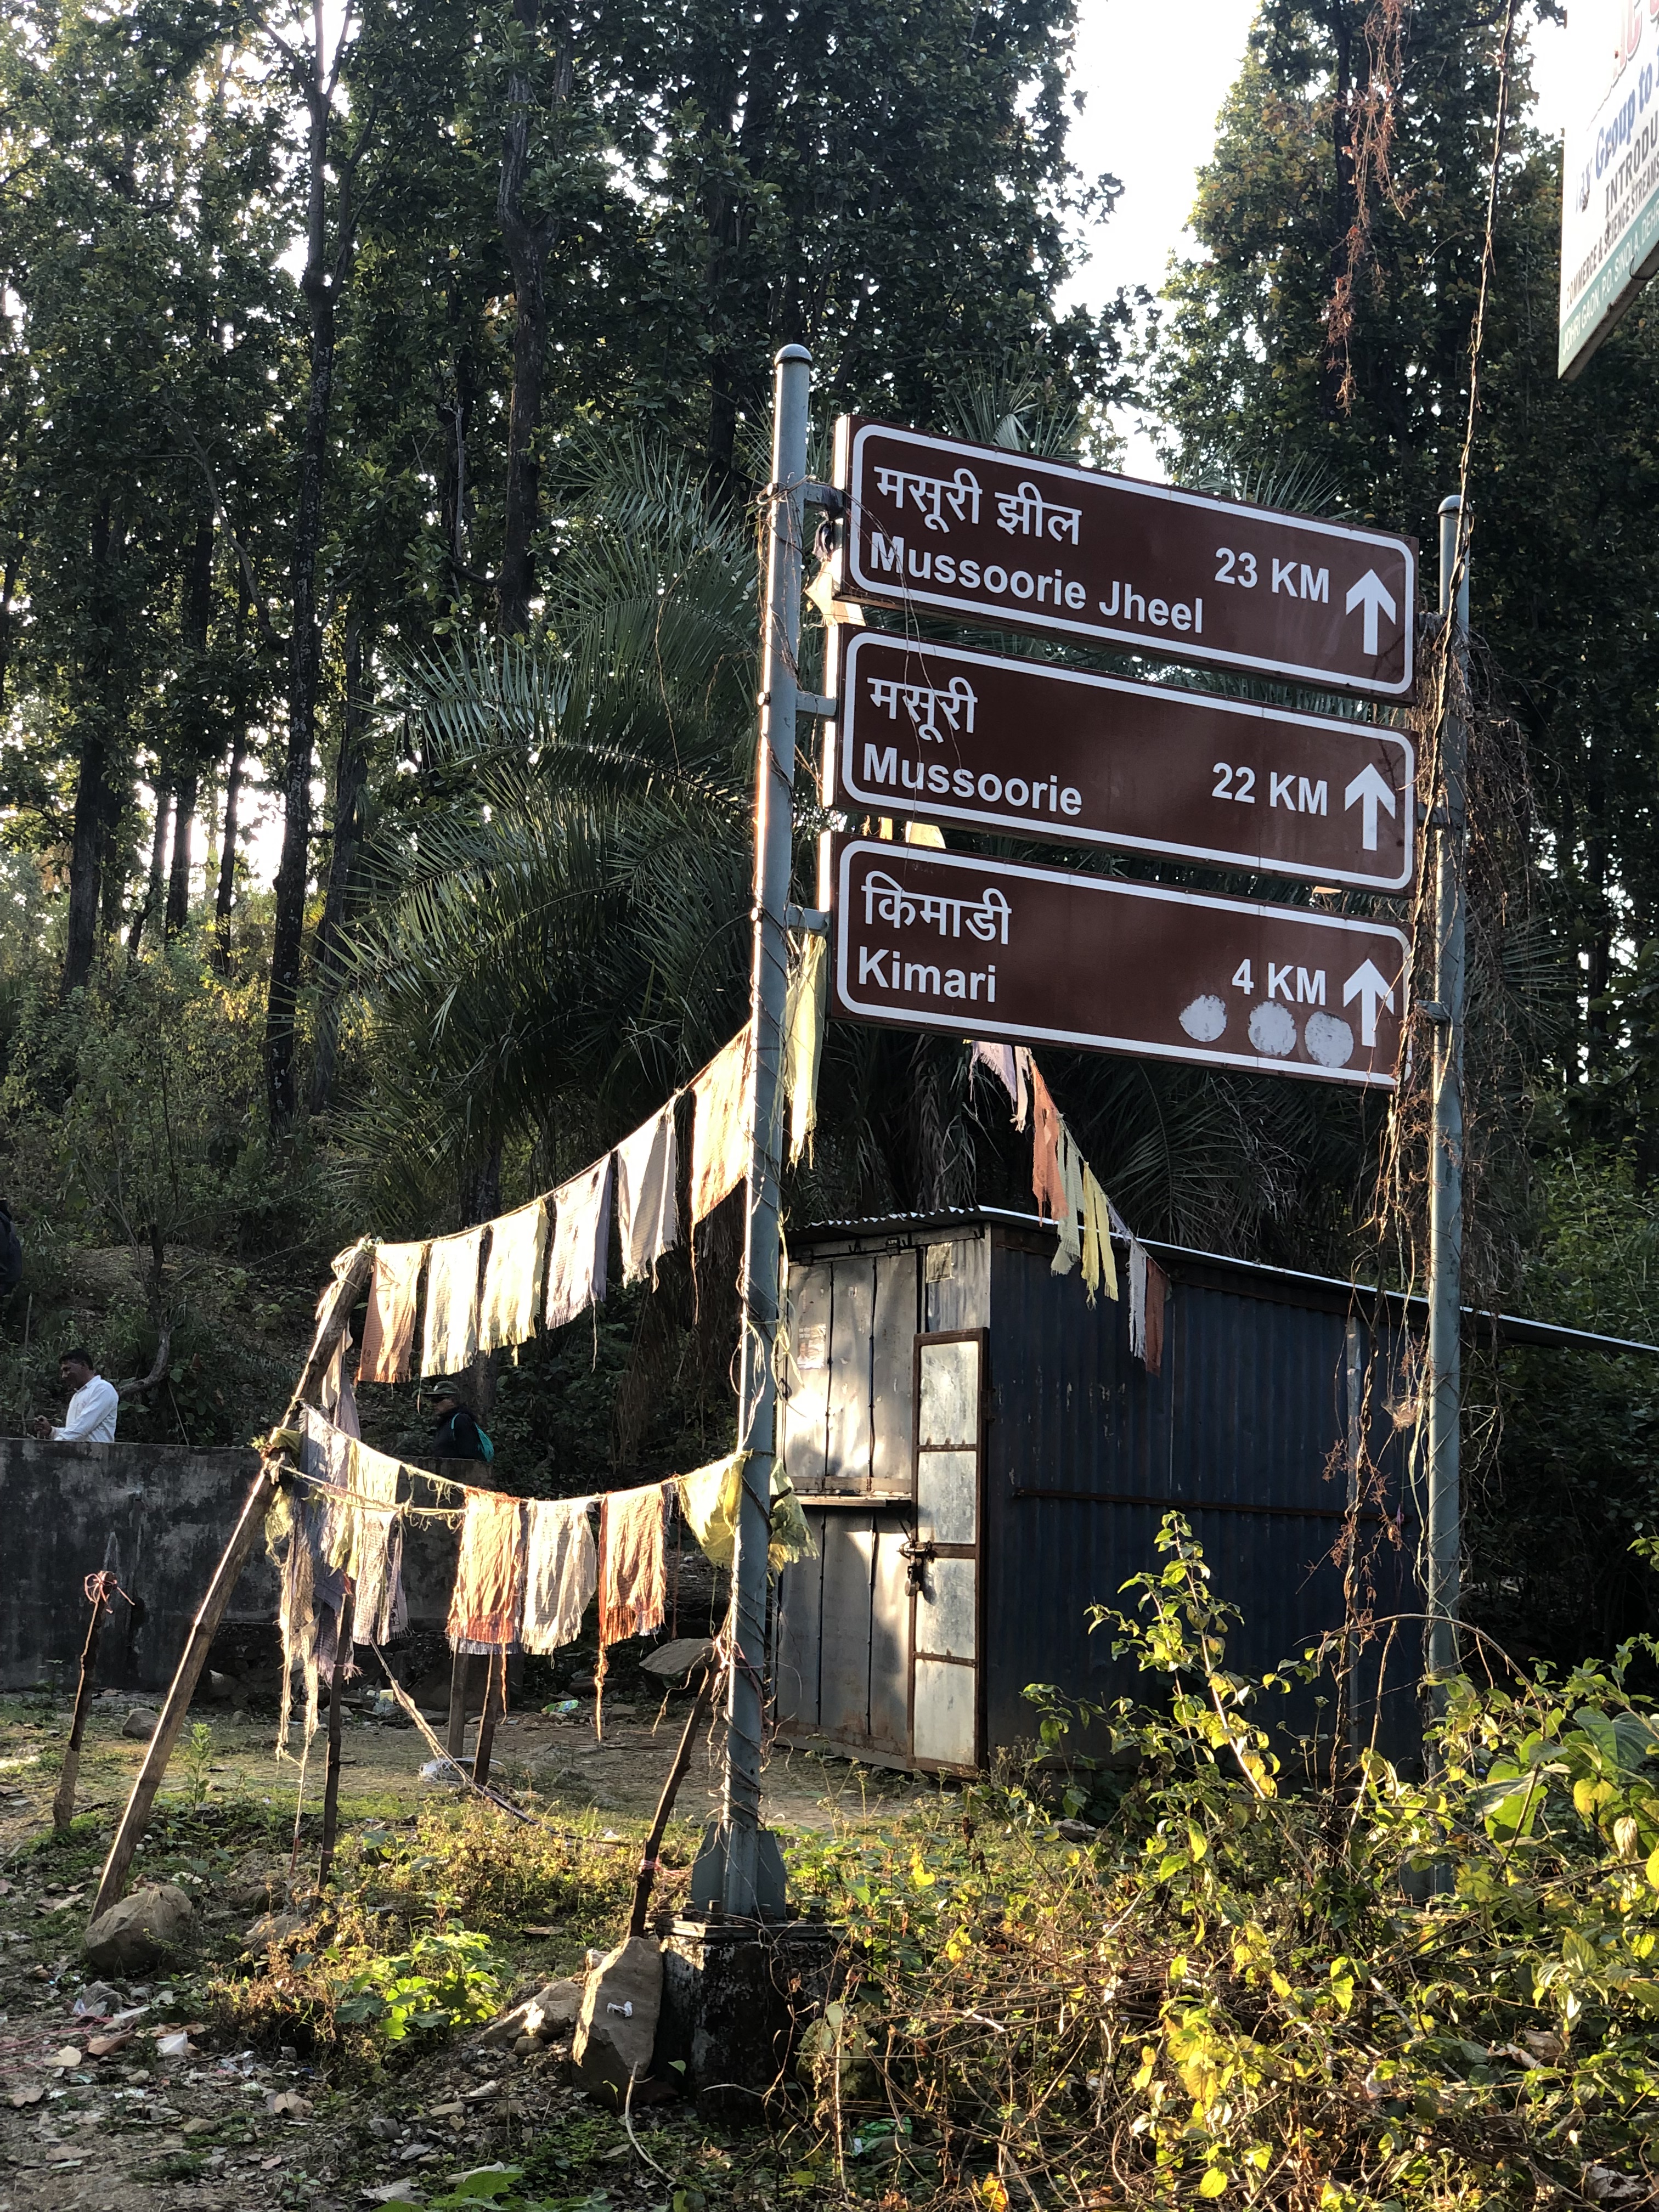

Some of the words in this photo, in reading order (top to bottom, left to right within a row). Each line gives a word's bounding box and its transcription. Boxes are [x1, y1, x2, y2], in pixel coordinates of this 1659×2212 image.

[1595, 89, 1635, 180] Group
[1638, 63, 1652, 114] to
[1605, 110, 1658, 218] INTRODU
[1566, 244, 1597, 310] COMMERCE
[1598, 236, 1603, 263] &
[1604, 195, 1630, 256] SCIENCE
[1562, 311, 1581, 356] JOHRI
[872, 467, 983, 533] मसूरी
[994, 481, 1082, 545] झील
[870, 531, 1086, 610] Mussoorie
[1098, 580, 1203, 634] Jheel
[1215, 548, 1258, 588] 23
[1272, 558, 1329, 603] KM
[867, 676, 978, 743] मसूरी
[863, 743, 1082, 816] Mussoorie
[1211, 762, 1255, 804] 22
[1269, 771, 1328, 816] KM
[861, 870, 1012, 945] किमाडी
[859, 946, 996, 1004] Kimari
[1232, 958, 1254, 995] 4
[1268, 962, 1326, 1006] KM
